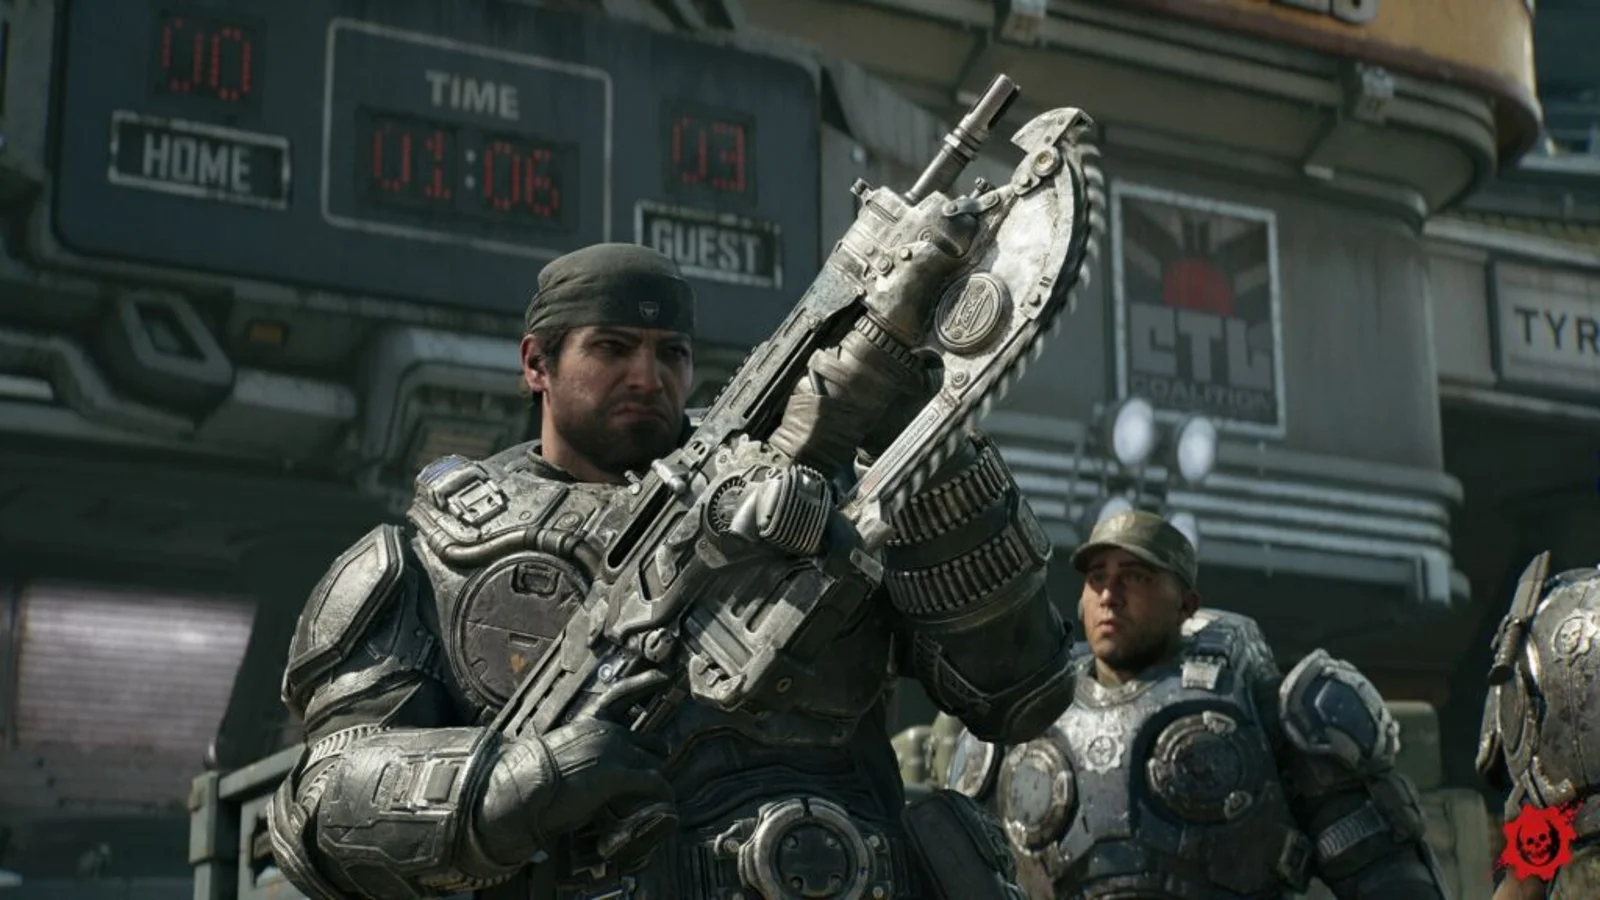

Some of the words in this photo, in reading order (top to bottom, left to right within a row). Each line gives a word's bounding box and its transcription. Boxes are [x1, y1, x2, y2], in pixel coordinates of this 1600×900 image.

[162, 18, 252, 100] 00
[426, 72, 519, 120] TIME
[143, 133, 251, 193] HOME
[671, 117, 746, 193] 03
[652, 219, 762, 274] GUEST
[1513, 305, 1600, 354] TYR
